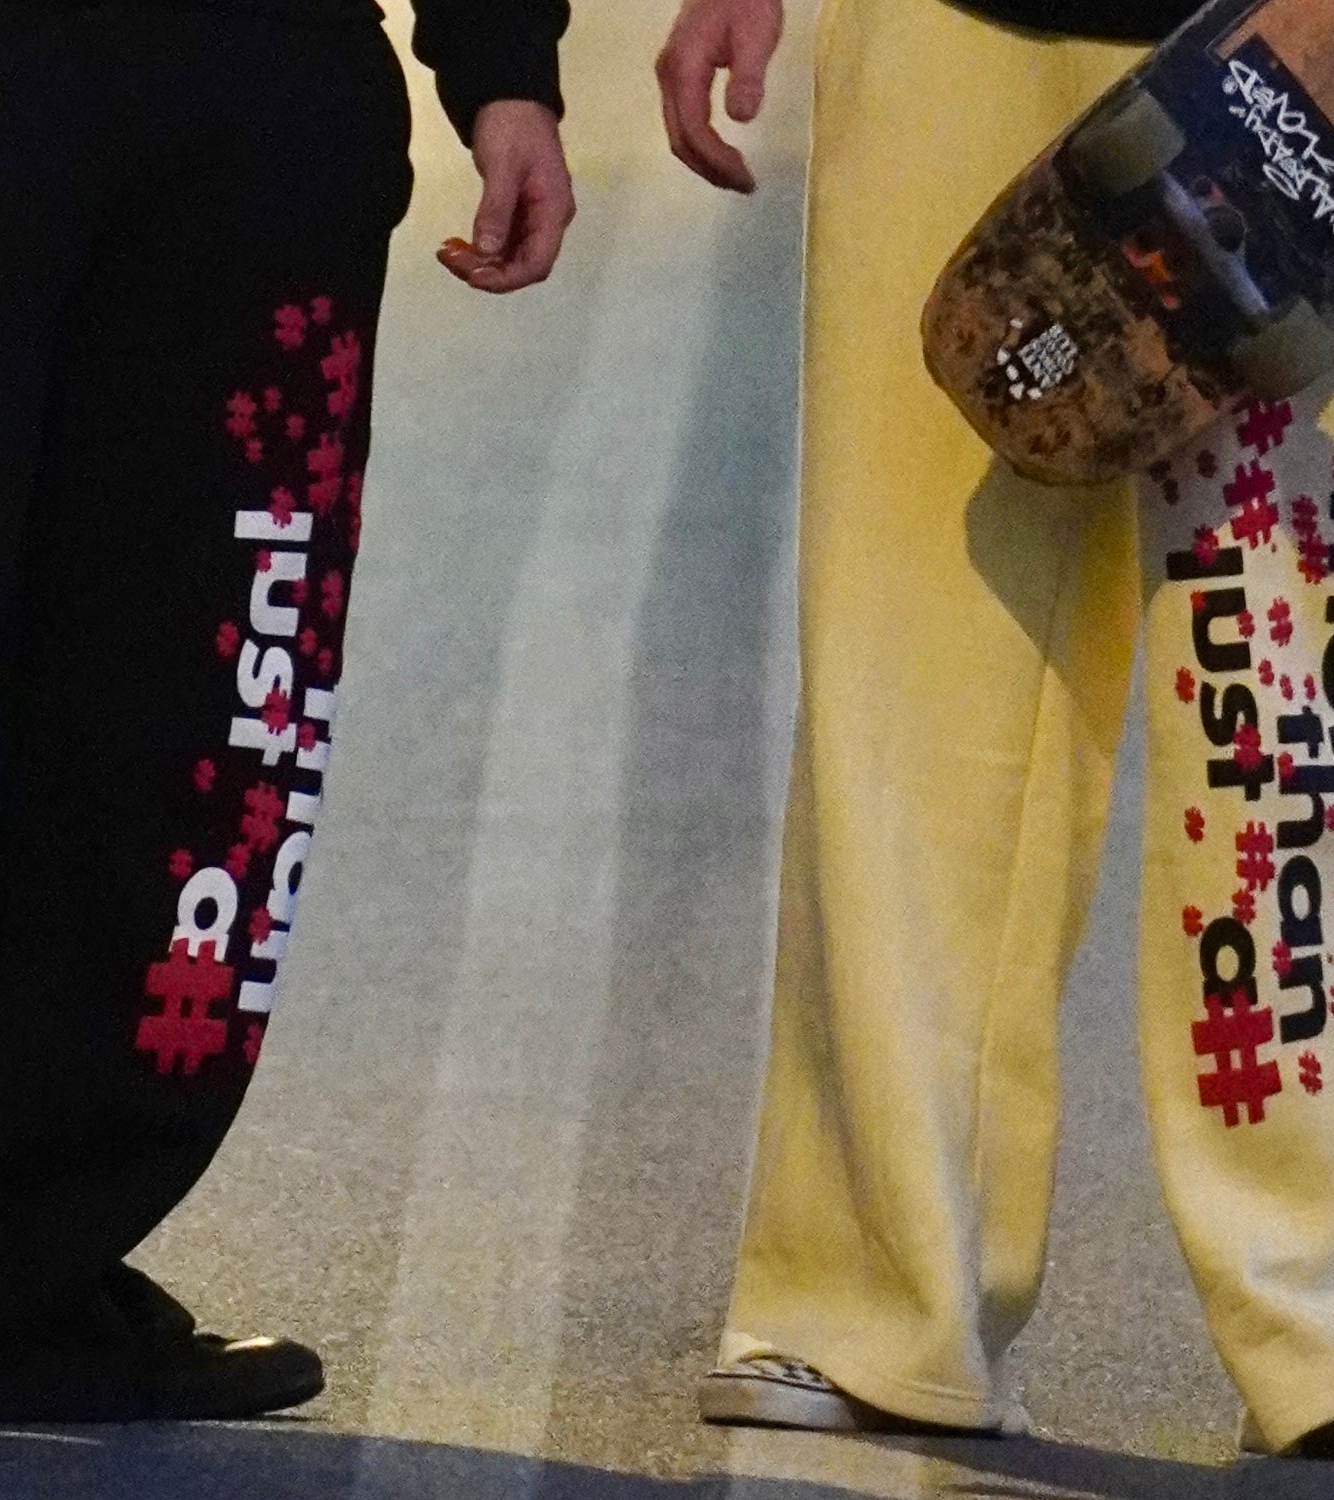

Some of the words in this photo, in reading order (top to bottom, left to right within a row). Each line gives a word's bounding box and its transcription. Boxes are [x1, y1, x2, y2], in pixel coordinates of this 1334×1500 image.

[229, 510, 313, 768] just
[1166, 547, 1274, 803] just
[169, 866, 238, 962] a
[1199, 915, 1258, 1008] a
